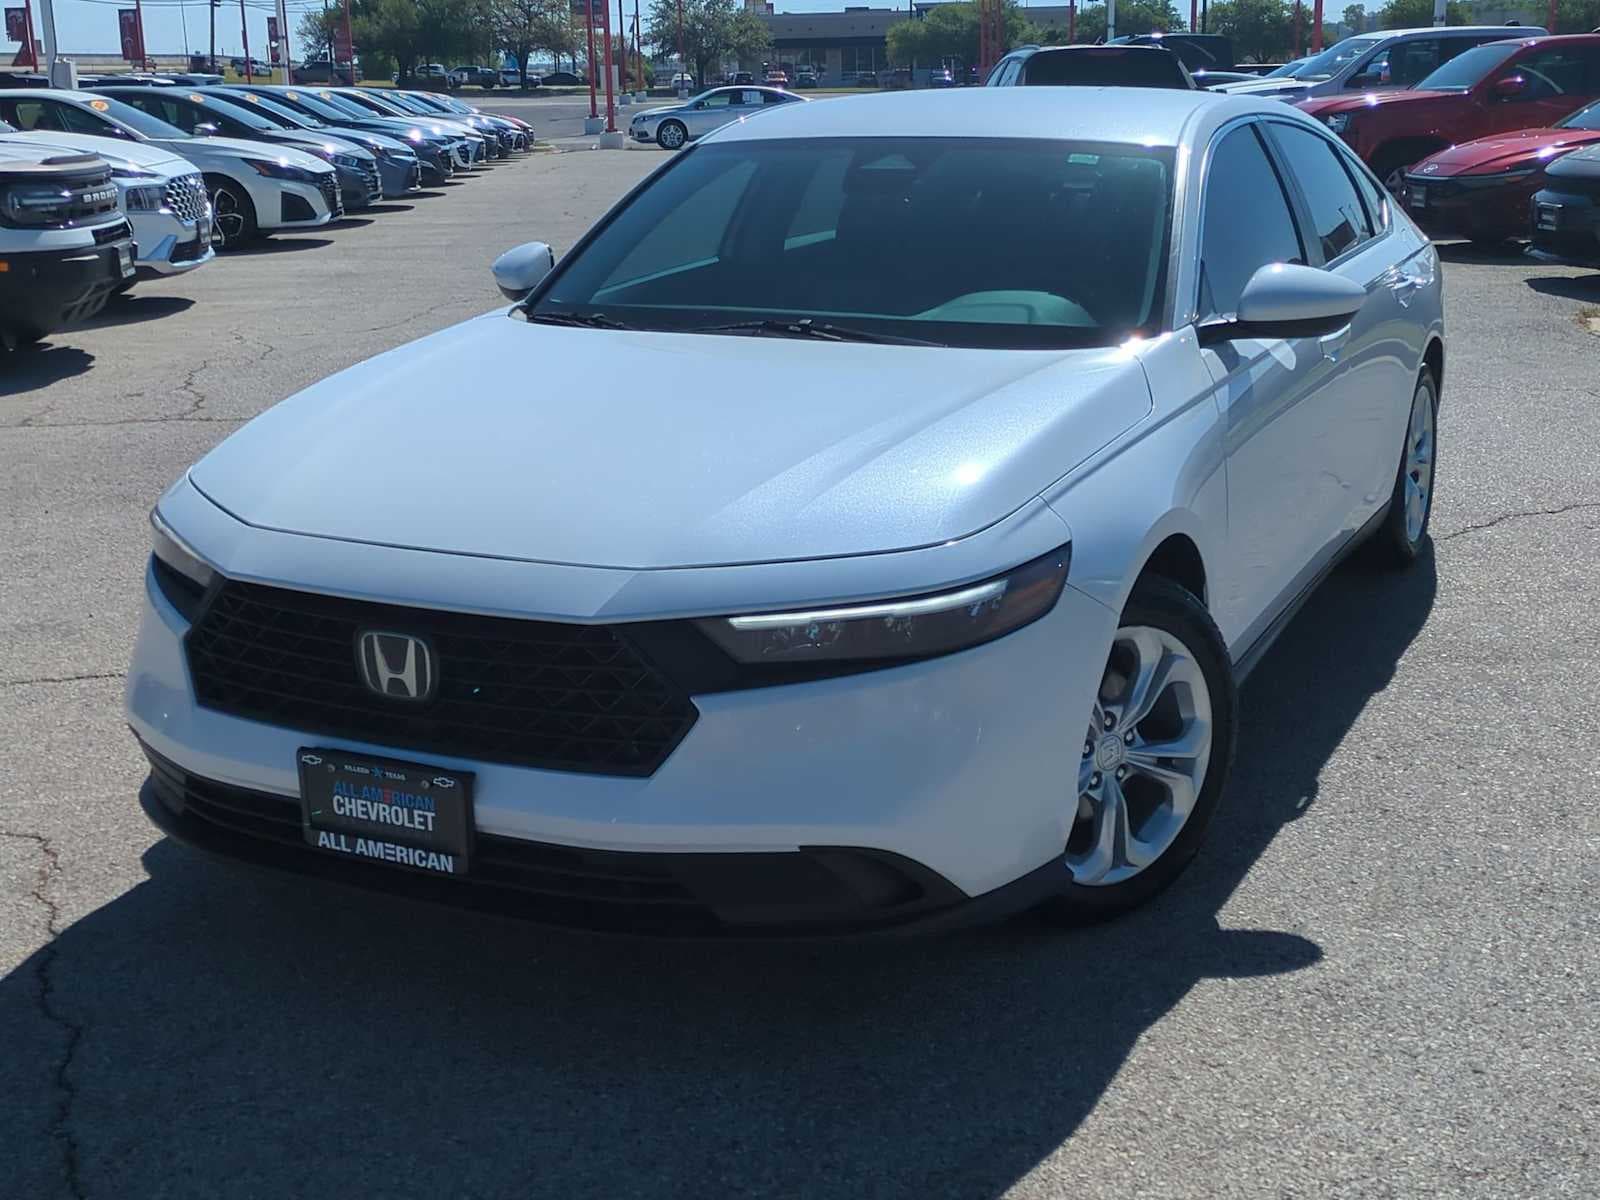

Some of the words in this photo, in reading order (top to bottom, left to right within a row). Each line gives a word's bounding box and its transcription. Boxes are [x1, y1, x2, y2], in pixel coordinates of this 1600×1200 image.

[333, 795, 436, 831] CHEVROLET
[334, 781, 357, 796] ALL
[361, 785, 435, 811] AMERICAN
[318, 831, 351, 853] ALL
[355, 839, 454, 873] AMERICAN
